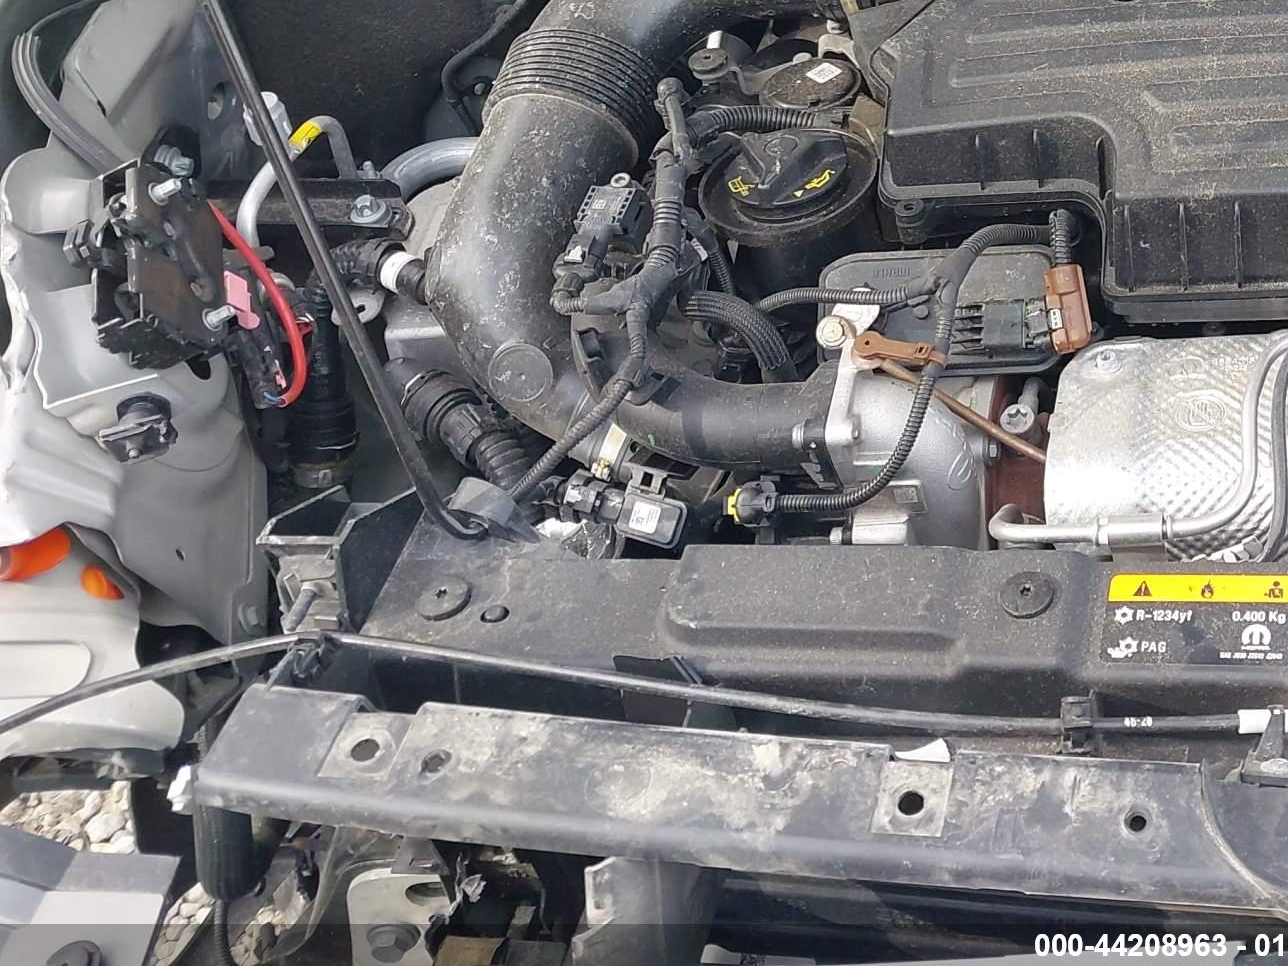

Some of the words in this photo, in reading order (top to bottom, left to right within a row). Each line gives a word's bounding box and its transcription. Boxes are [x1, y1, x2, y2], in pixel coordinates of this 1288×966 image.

[1136, 610, 1192, 622] R-1234yf
[1232, 611, 1266, 622] 0.400
[1268, 611, 1286, 624] Kg
[1141, 641, 1167, 652] PAG
